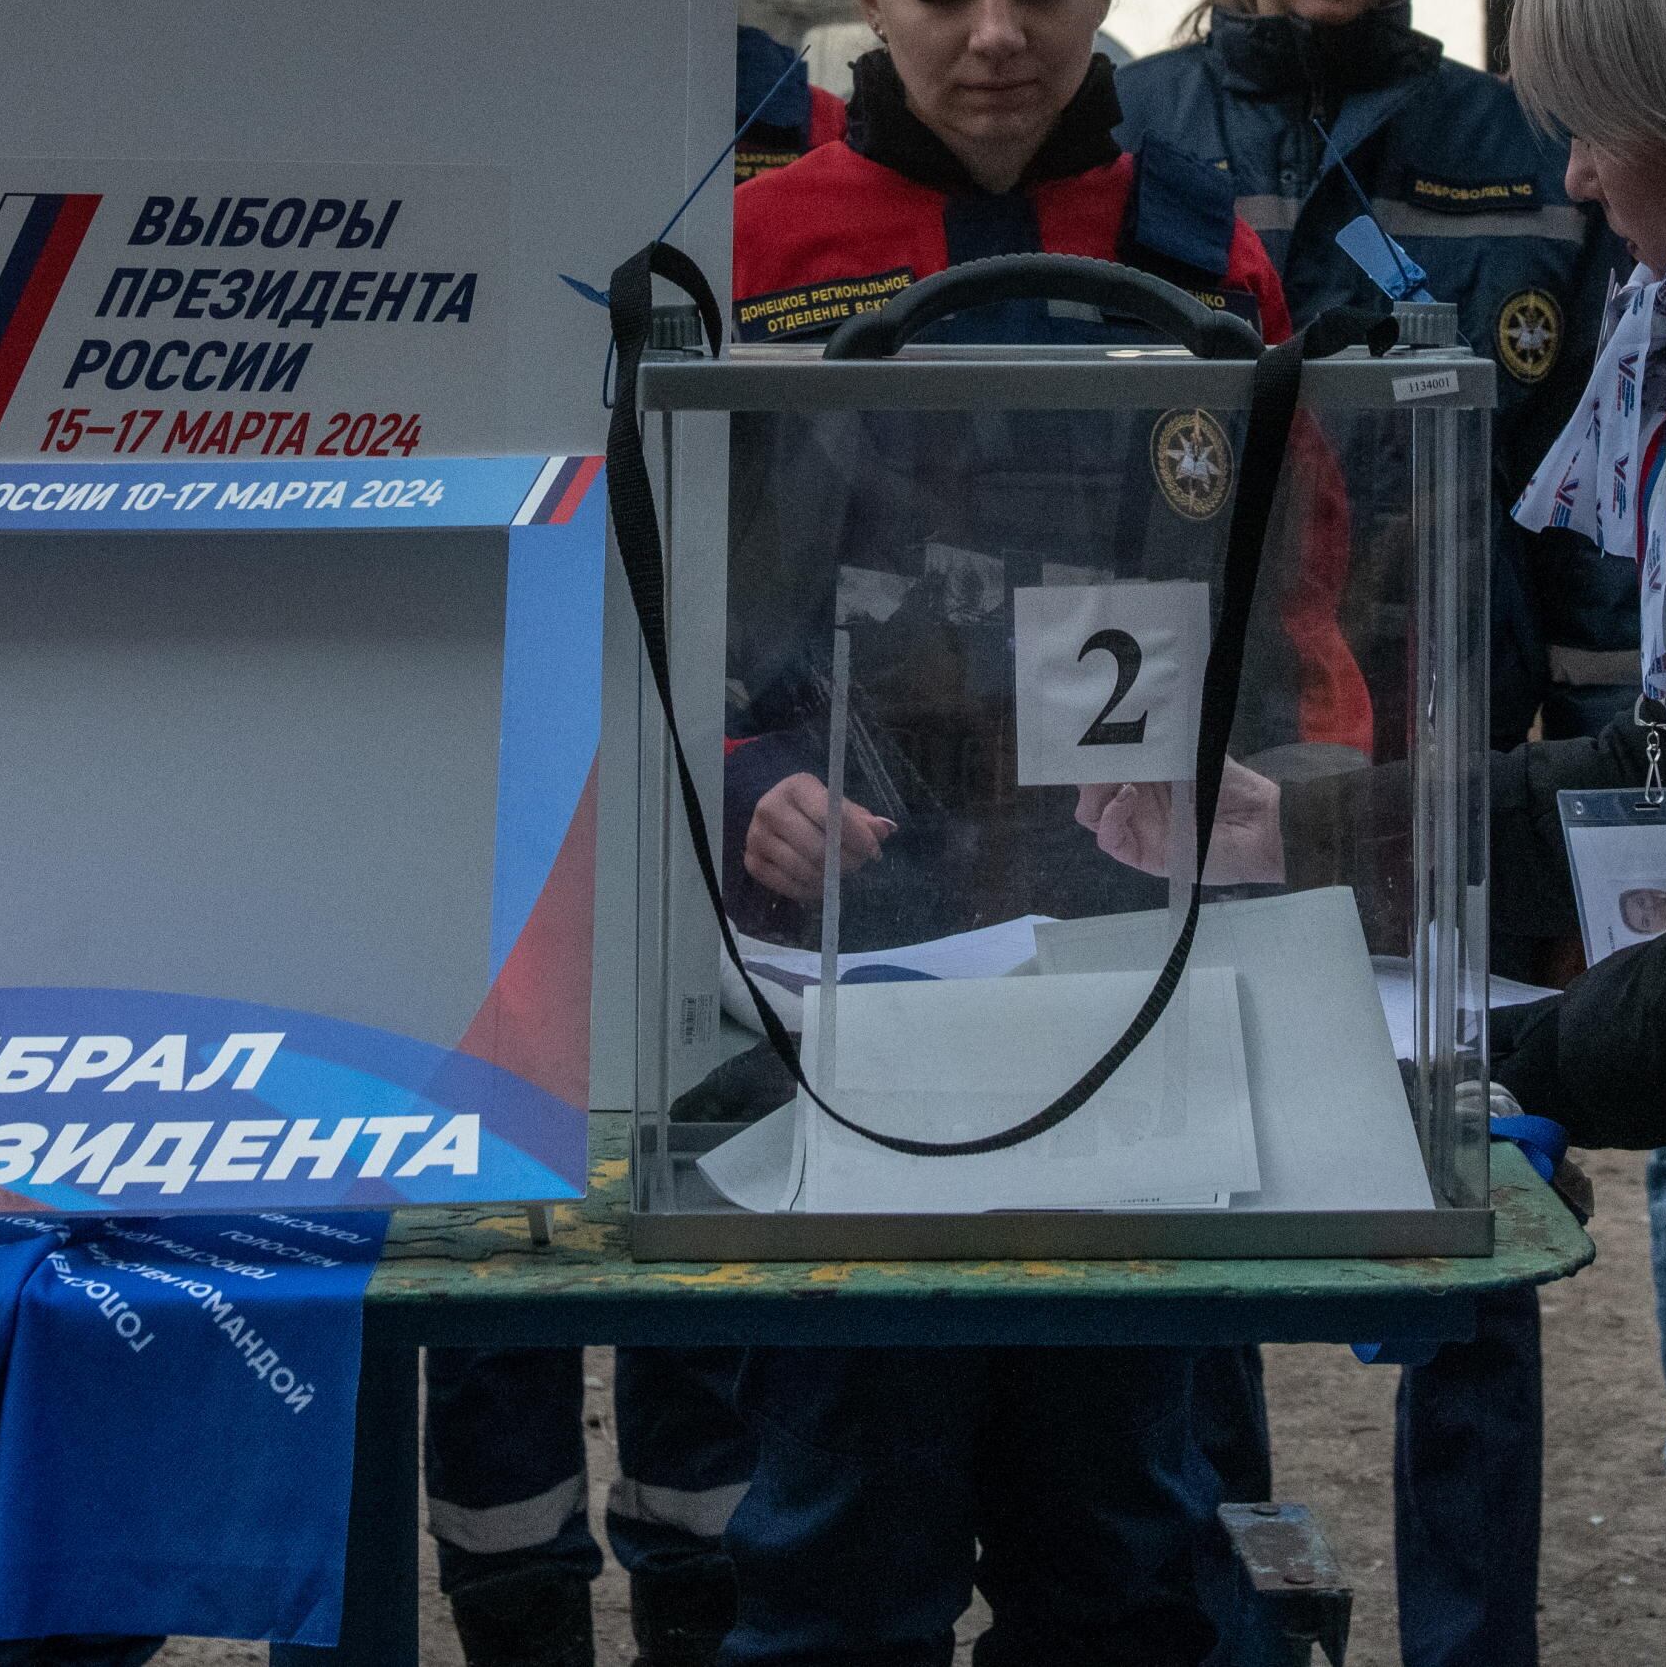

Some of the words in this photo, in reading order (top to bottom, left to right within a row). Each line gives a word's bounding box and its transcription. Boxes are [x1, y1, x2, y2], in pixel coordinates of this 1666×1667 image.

[127, 195, 402, 250] ВЫБОРЫ
[95, 267, 480, 330] ПРЕЗИДЕНТА
[740, 293, 808, 323] ДОНЕЦКОЕ
[811, 274, 911, 304] РЕГИОНАЛЬНОЕ
[767, 304, 850, 332] ОТДЕЛЕНИЕ
[62, 338, 313, 394] РОССИИ
[1408, 377, 1451, 394] 1134001
[166, 410, 310, 456] МАРТА
[315, 412, 422, 458] 2024
[121, 482, 212, 512] 10-17
[213, 481, 343, 510] МАРТА
[350, 478, 446, 509] 2024
[1076, 628, 1149, 747] 2
[174, 1278, 317, 1415] КОМАНДОЙ
